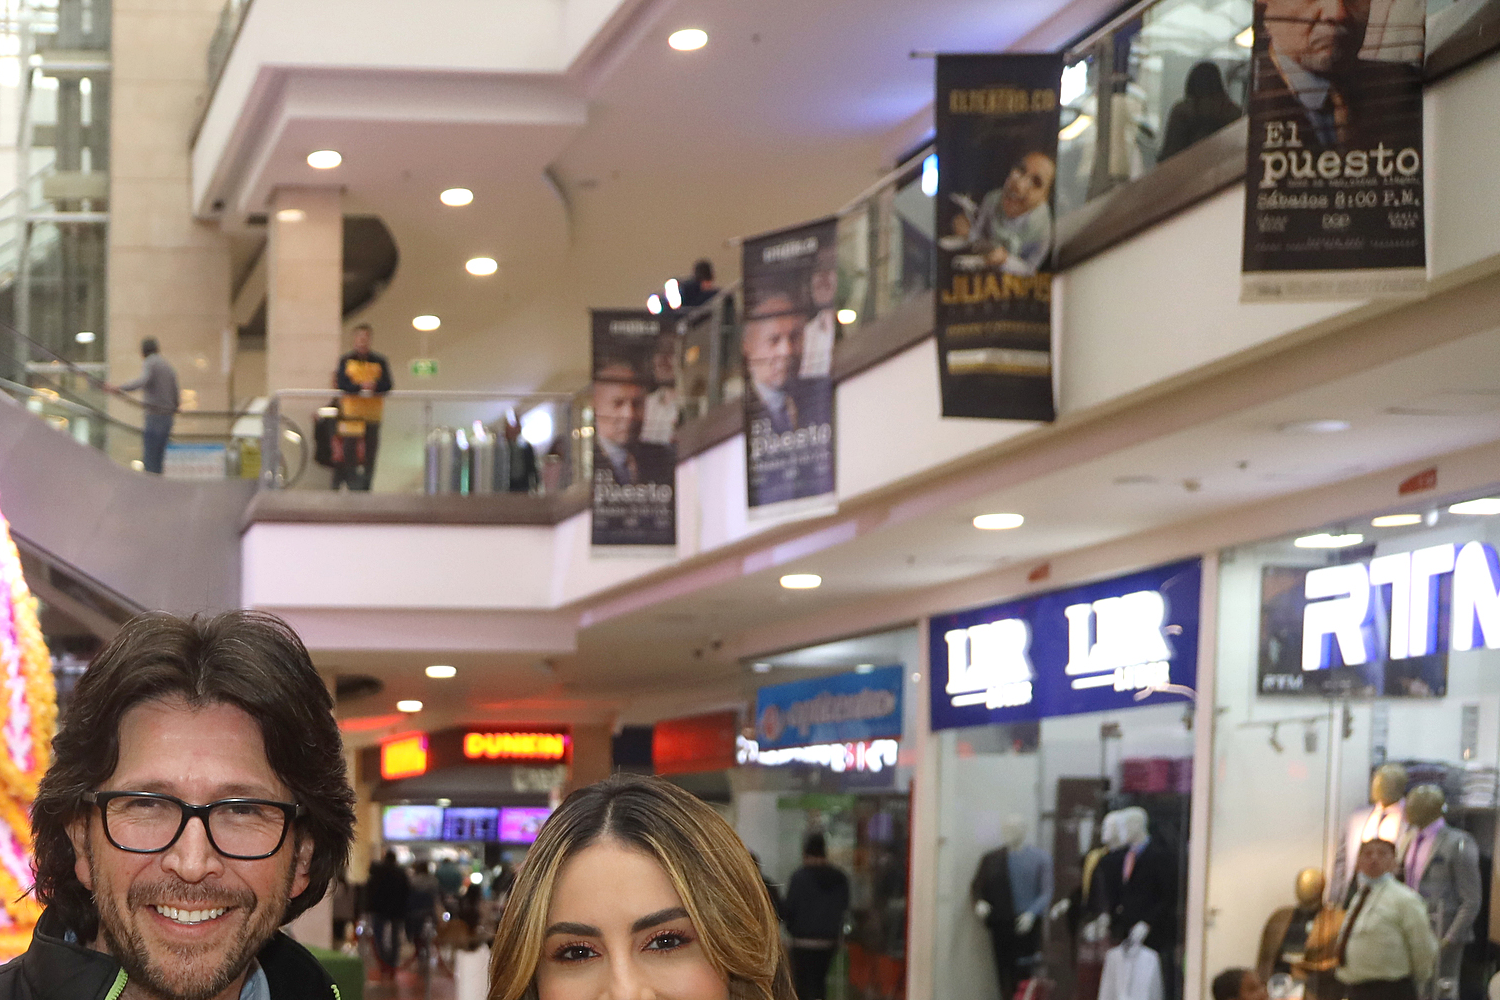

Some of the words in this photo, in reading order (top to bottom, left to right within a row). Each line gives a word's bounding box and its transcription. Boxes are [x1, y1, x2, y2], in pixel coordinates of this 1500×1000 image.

[1263, 121, 1303, 149] El
[1259, 142, 1420, 189] puesto
[1257, 190, 1329, 211] Sábados
[1335, 190, 1377, 210] 8:00
[1383, 187, 1420, 208] P.M.
[464, 732, 565, 760] DUNKIN
